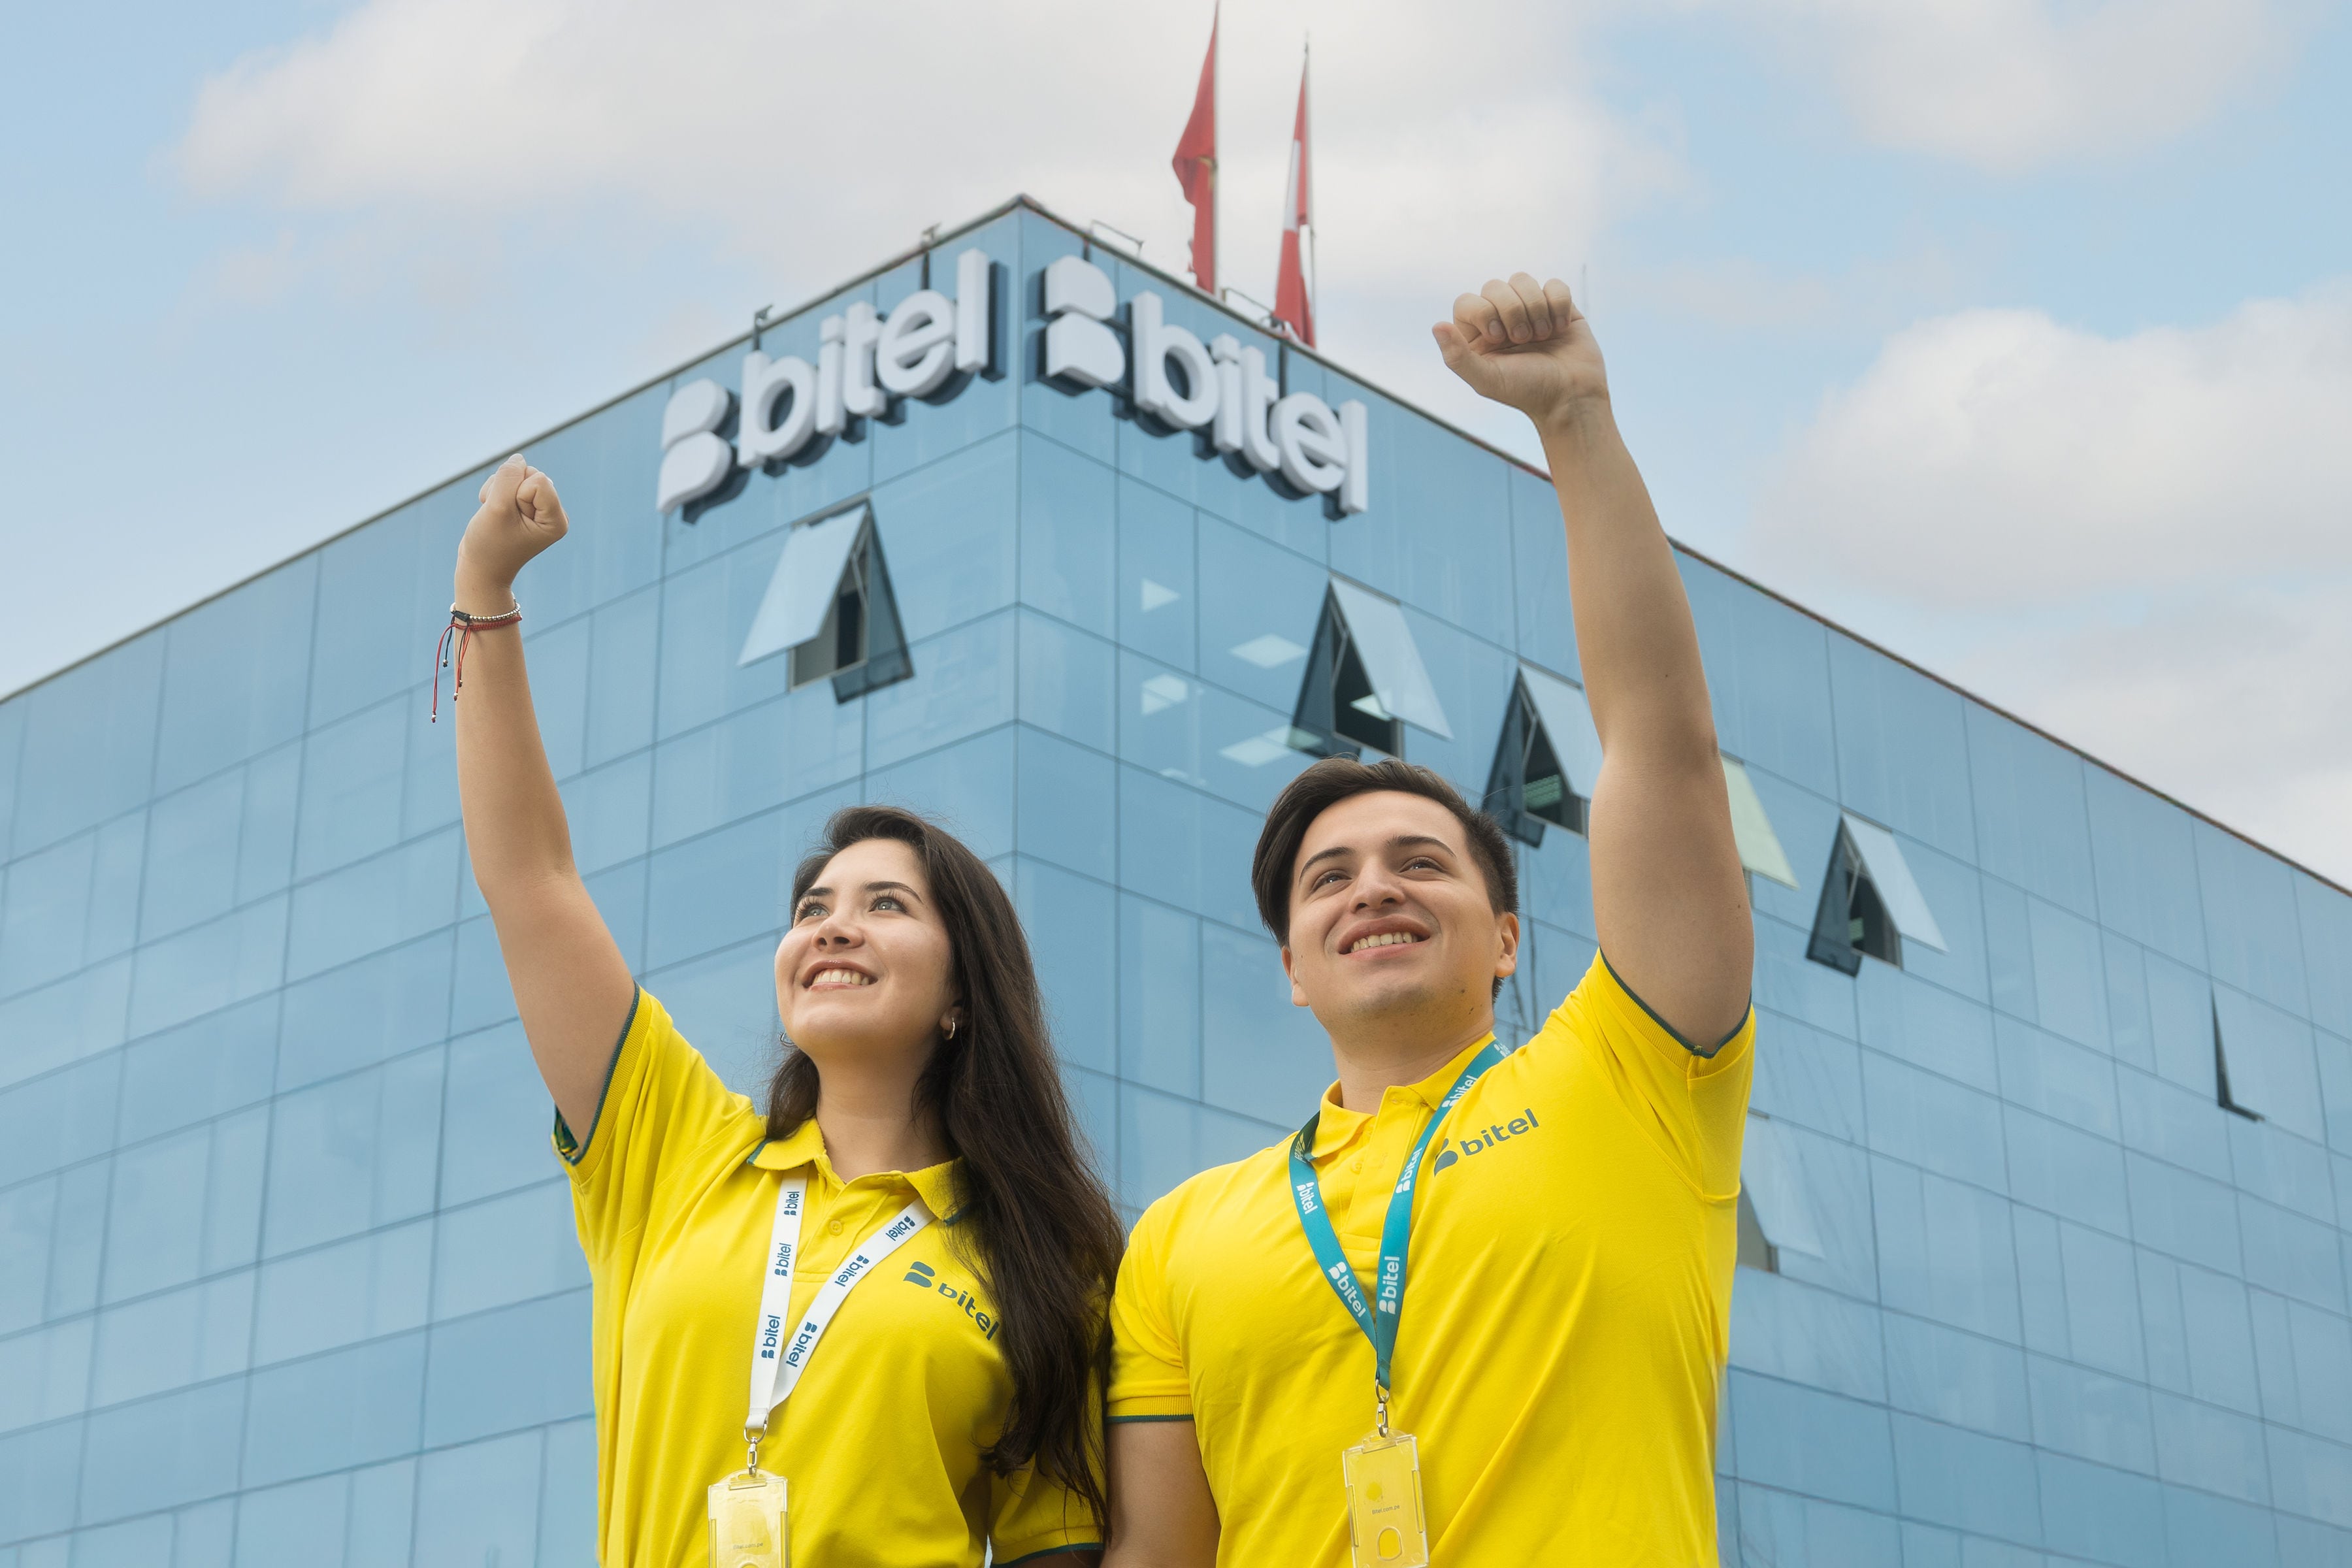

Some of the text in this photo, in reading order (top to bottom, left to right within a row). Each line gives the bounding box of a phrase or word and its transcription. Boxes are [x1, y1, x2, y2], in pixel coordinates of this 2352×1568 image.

[737, 249, 988, 468] bitel
[1132, 291, 1367, 514] bitel
[1460, 1108, 1539, 1156] bitel
[784, 1191, 800, 1209] bitel
[1299, 1187, 1318, 1215] bitel
[885, 1220, 910, 1241] bitel
[776, 1243, 791, 1267] bitel
[834, 1262, 864, 1287] bitel
[1382, 1256, 1399, 1299] bitel
[938, 1282, 1000, 1341] bitel
[1337, 1275, 1366, 1317] bitel
[763, 1315, 780, 1347] bitel
[786, 1333, 812, 1367] bitel
